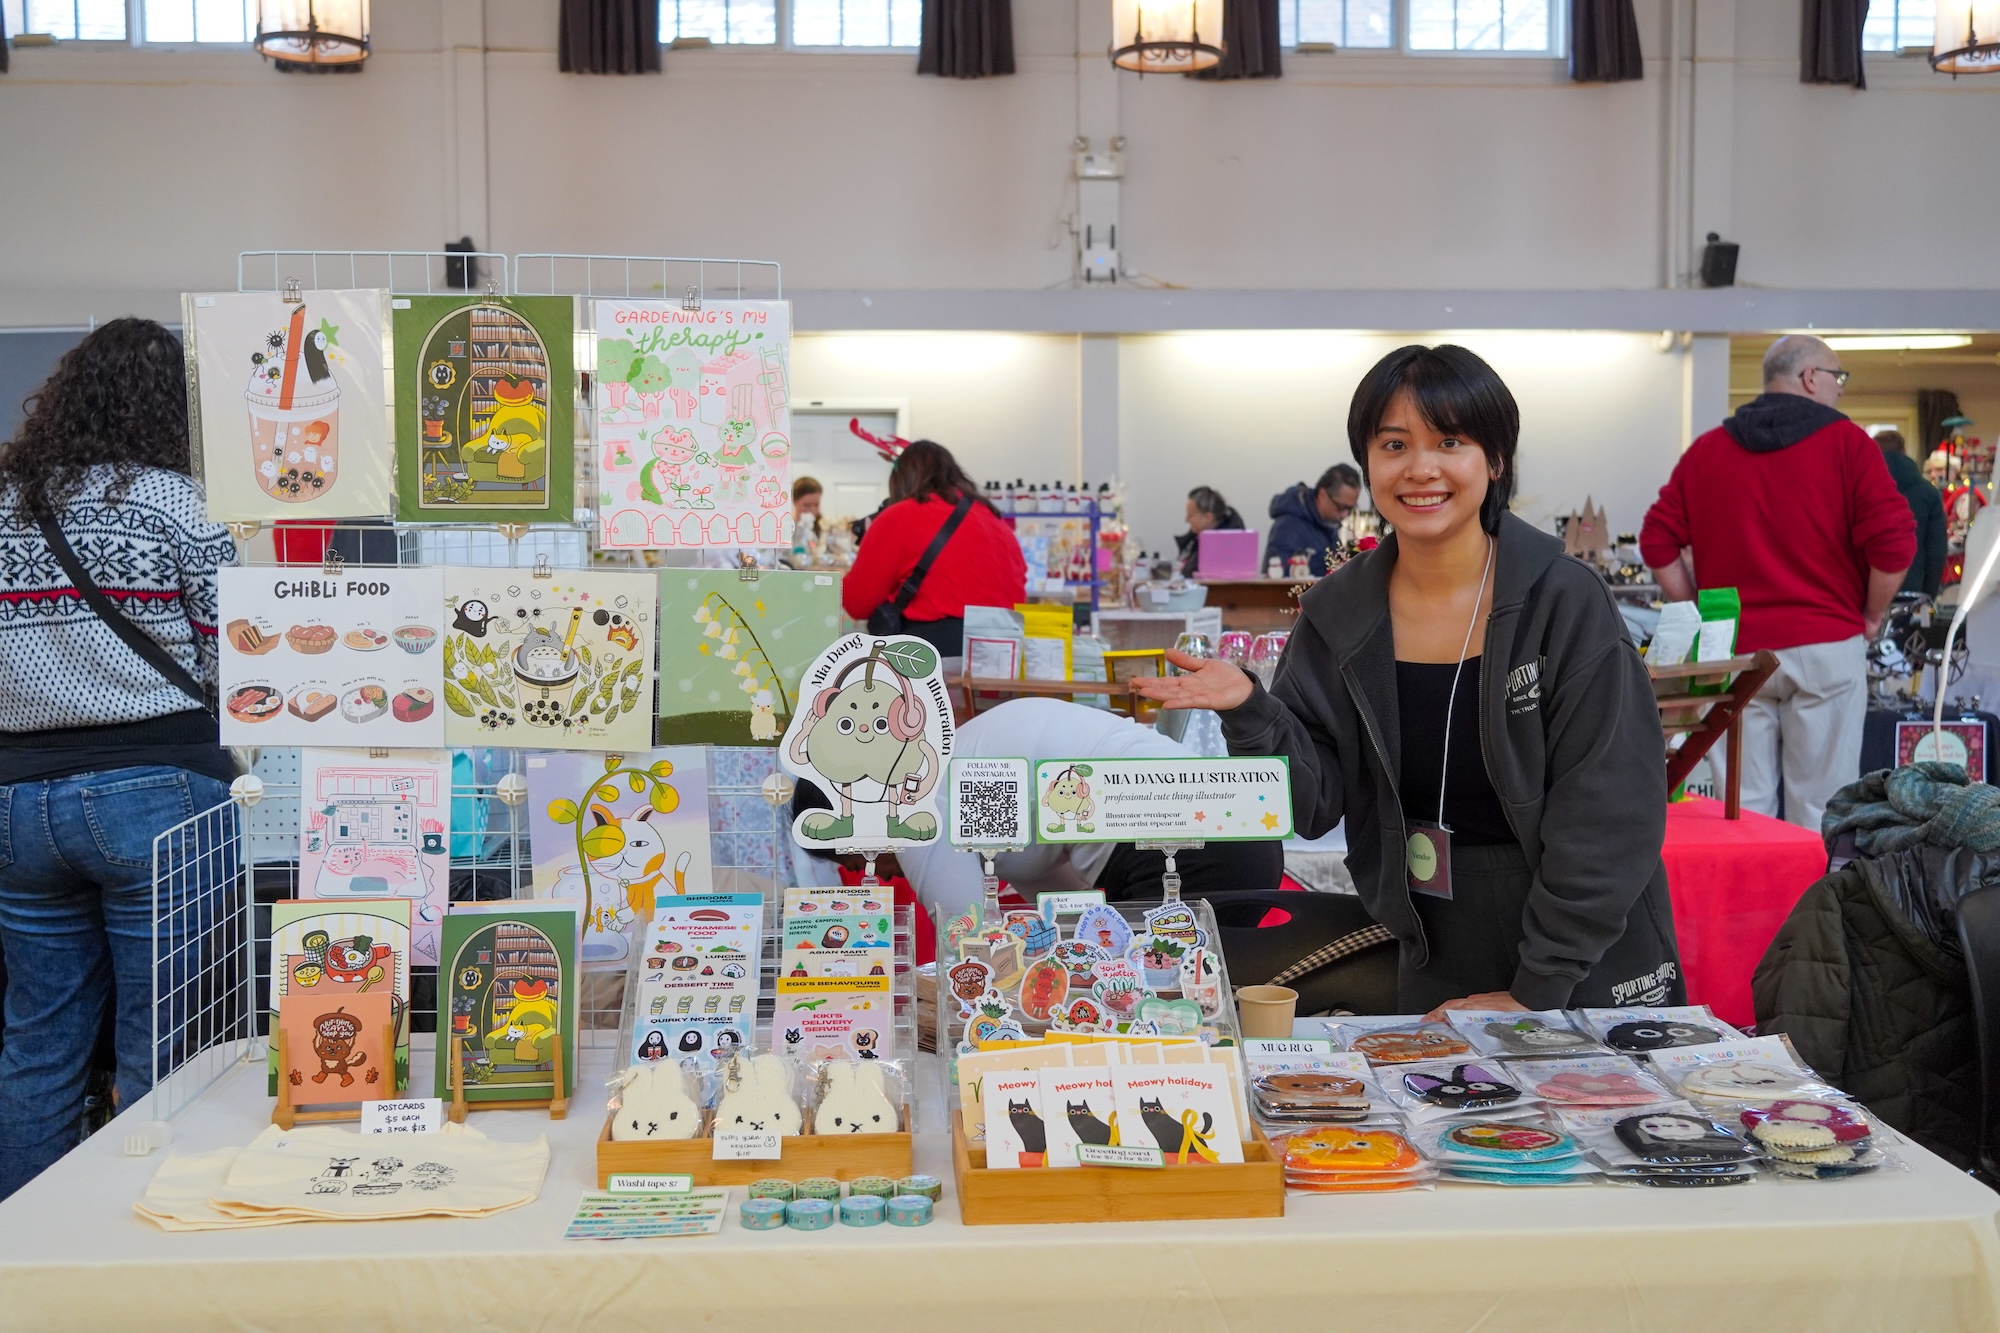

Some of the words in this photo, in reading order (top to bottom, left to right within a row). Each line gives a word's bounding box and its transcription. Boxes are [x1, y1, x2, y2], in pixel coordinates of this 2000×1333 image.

[615, 311, 733, 324] GARDENING'S
[743, 311, 767, 324] MY
[634, 325, 751, 356] therapy
[347, 582, 390, 596] FOOD
[811, 666, 832, 688] Mia
[828, 634, 863, 664] Dang
[926, 678, 954, 755] Illustration
[1104, 774, 1131, 785] MIA
[1135, 773, 1175, 784] DANG
[1179, 772, 1279, 783] ILLUSTRATION
[1104, 792, 1151, 804] professional
[1153, 793, 1168, 801] cute
[1169, 792, 1193, 802] thing
[1195, 791, 1237, 800] illustrator
[1411, 851, 1431, 861] Vendor
[650, 1016, 688, 1024] QUIRKY
[1261, 1043, 1287, 1052] MUG
[1290, 1043, 1313, 1052] RUG
[998, 1081, 1037, 1091] Meowy
[1054, 1081, 1093, 1092] Meowy
[1127, 1078, 1166, 1089] Meowy
[1167, 1077, 1213, 1090] holidays
[377, 1102, 426, 1112] POSTCARDS
[385, 1115, 398, 1125] $5
[387, 1126, 393, 1134] 3
[412, 1123, 426, 1133] $13
[1085, 1147, 1127, 1156] Greeting
[617, 1179, 646, 1188] Washi
[647, 1180, 668, 1189] tape
